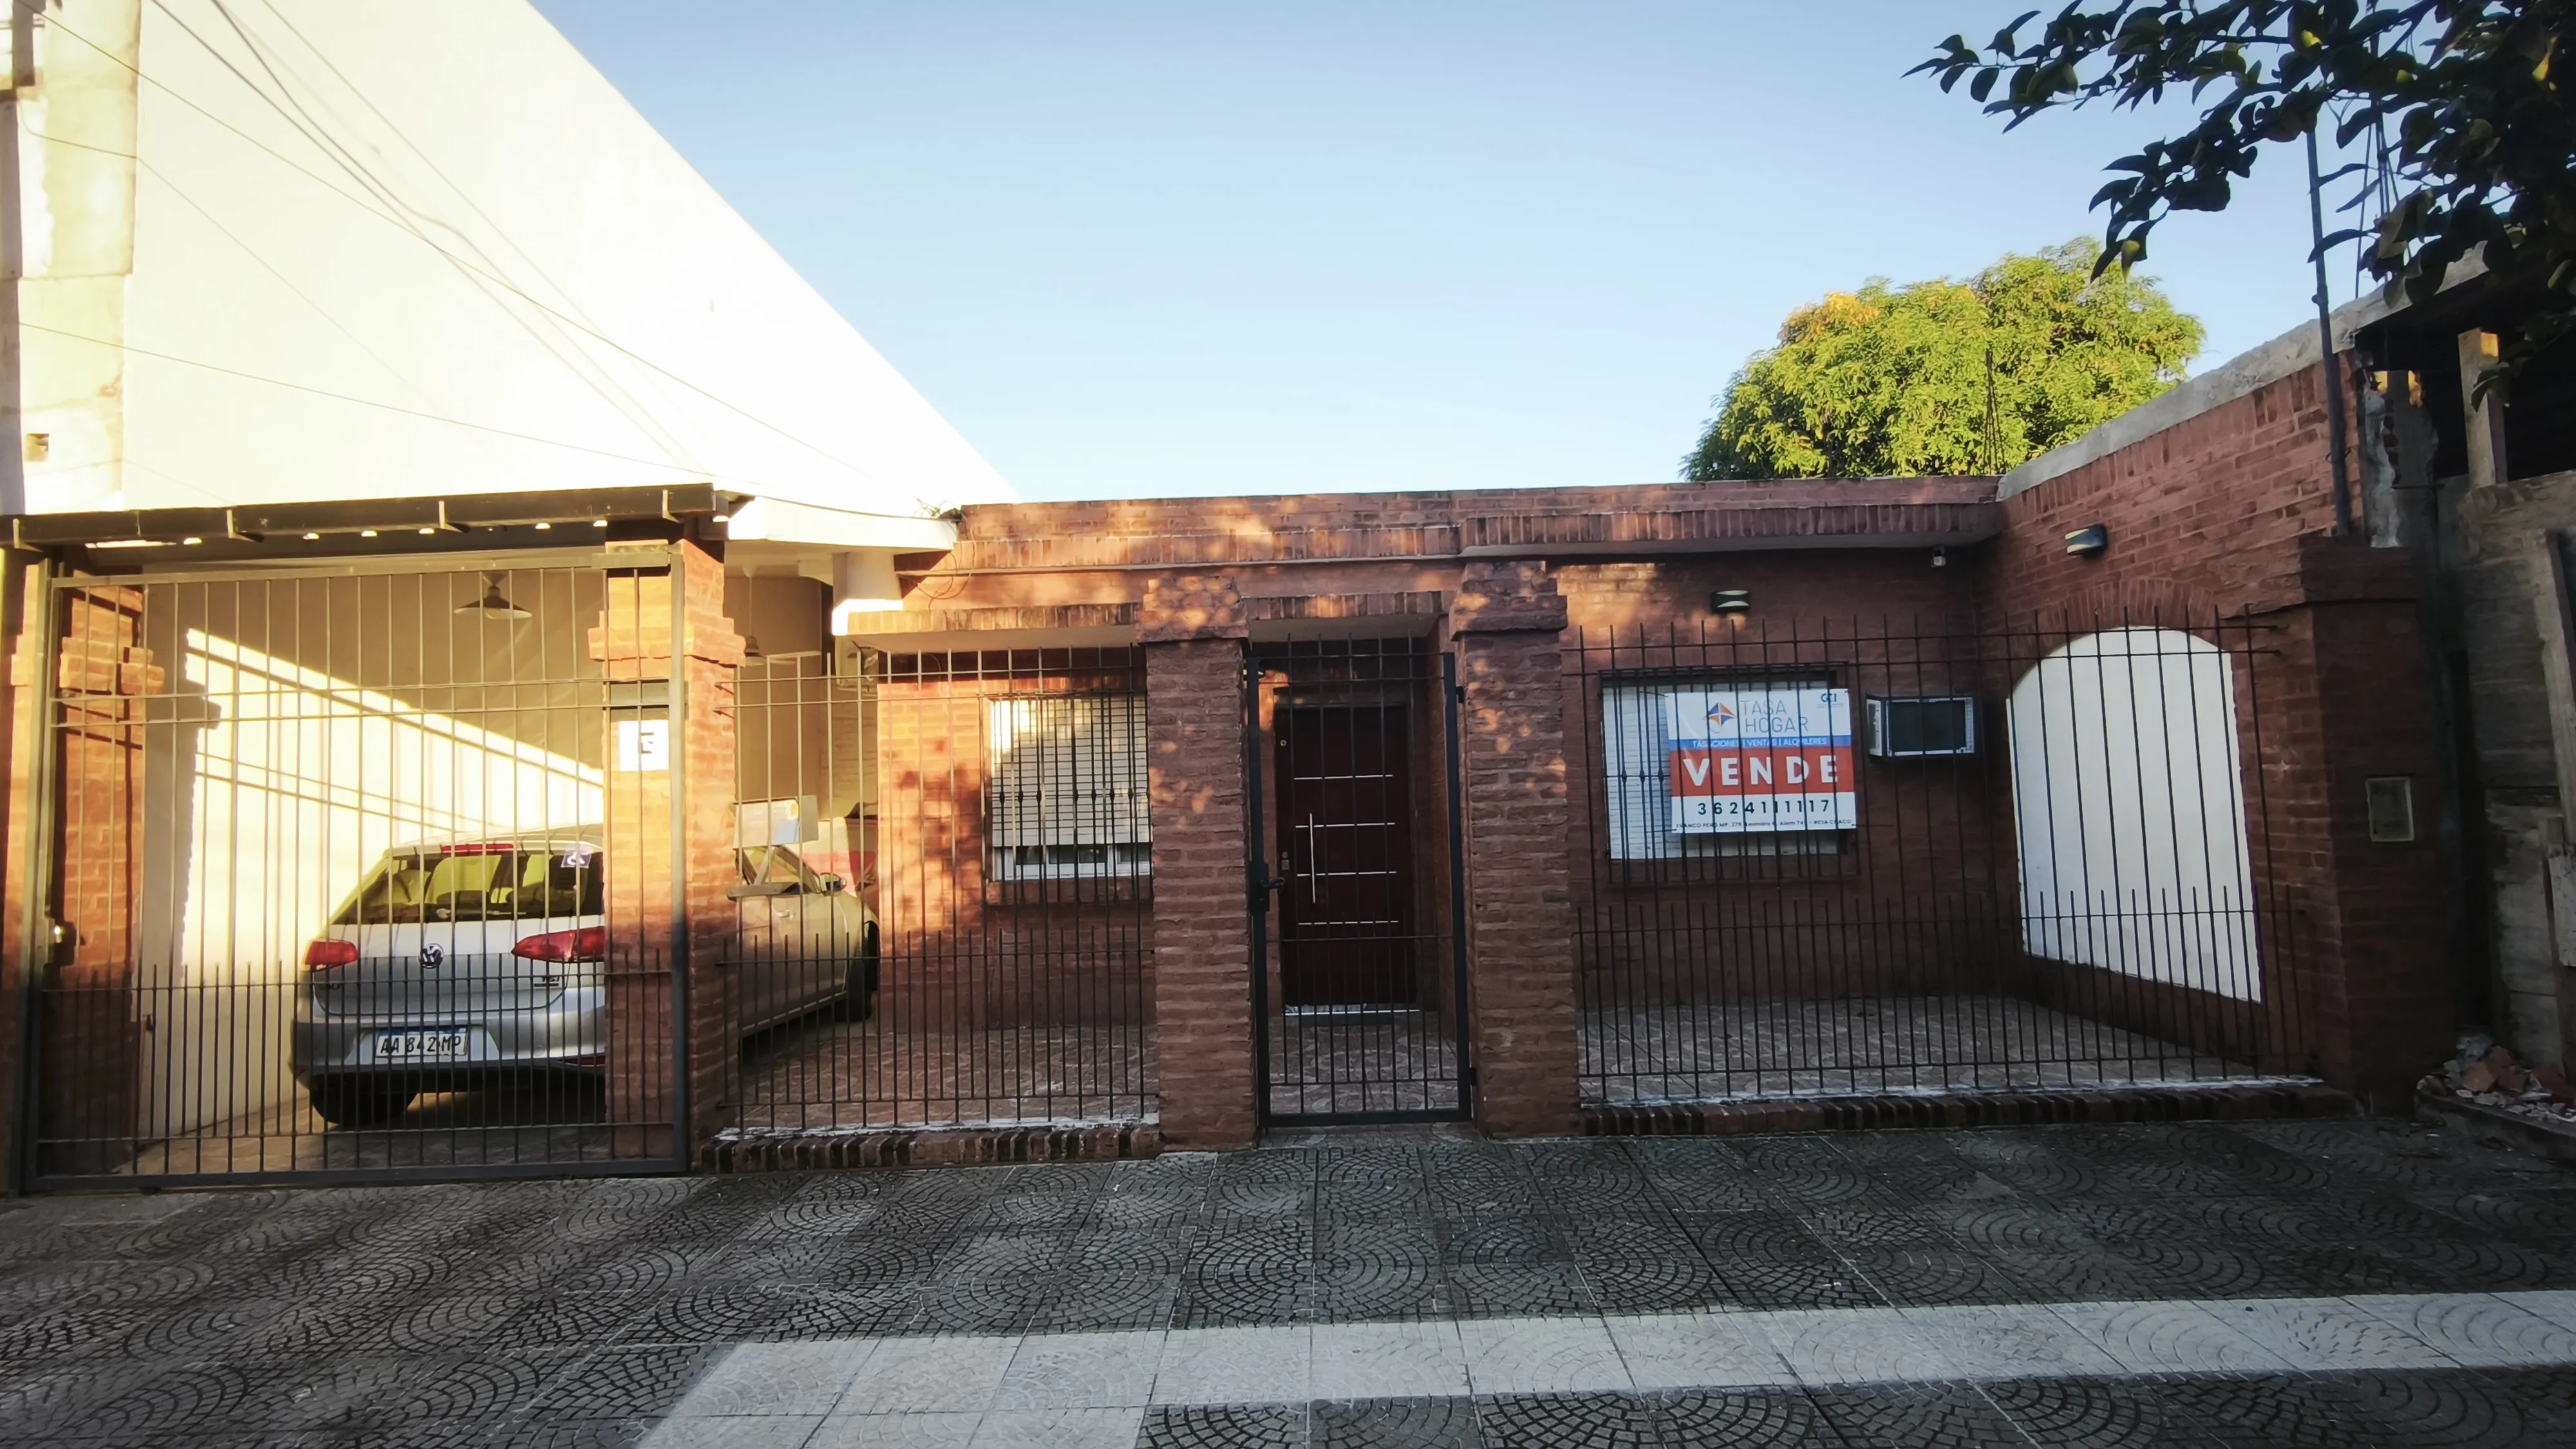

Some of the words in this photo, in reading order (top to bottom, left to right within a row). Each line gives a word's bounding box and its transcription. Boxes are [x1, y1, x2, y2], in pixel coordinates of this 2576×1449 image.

[1740, 700, 1786, 715] TASA
[1745, 716, 1808, 733] HOGAR
[1683, 755, 1837, 786] VENDE
